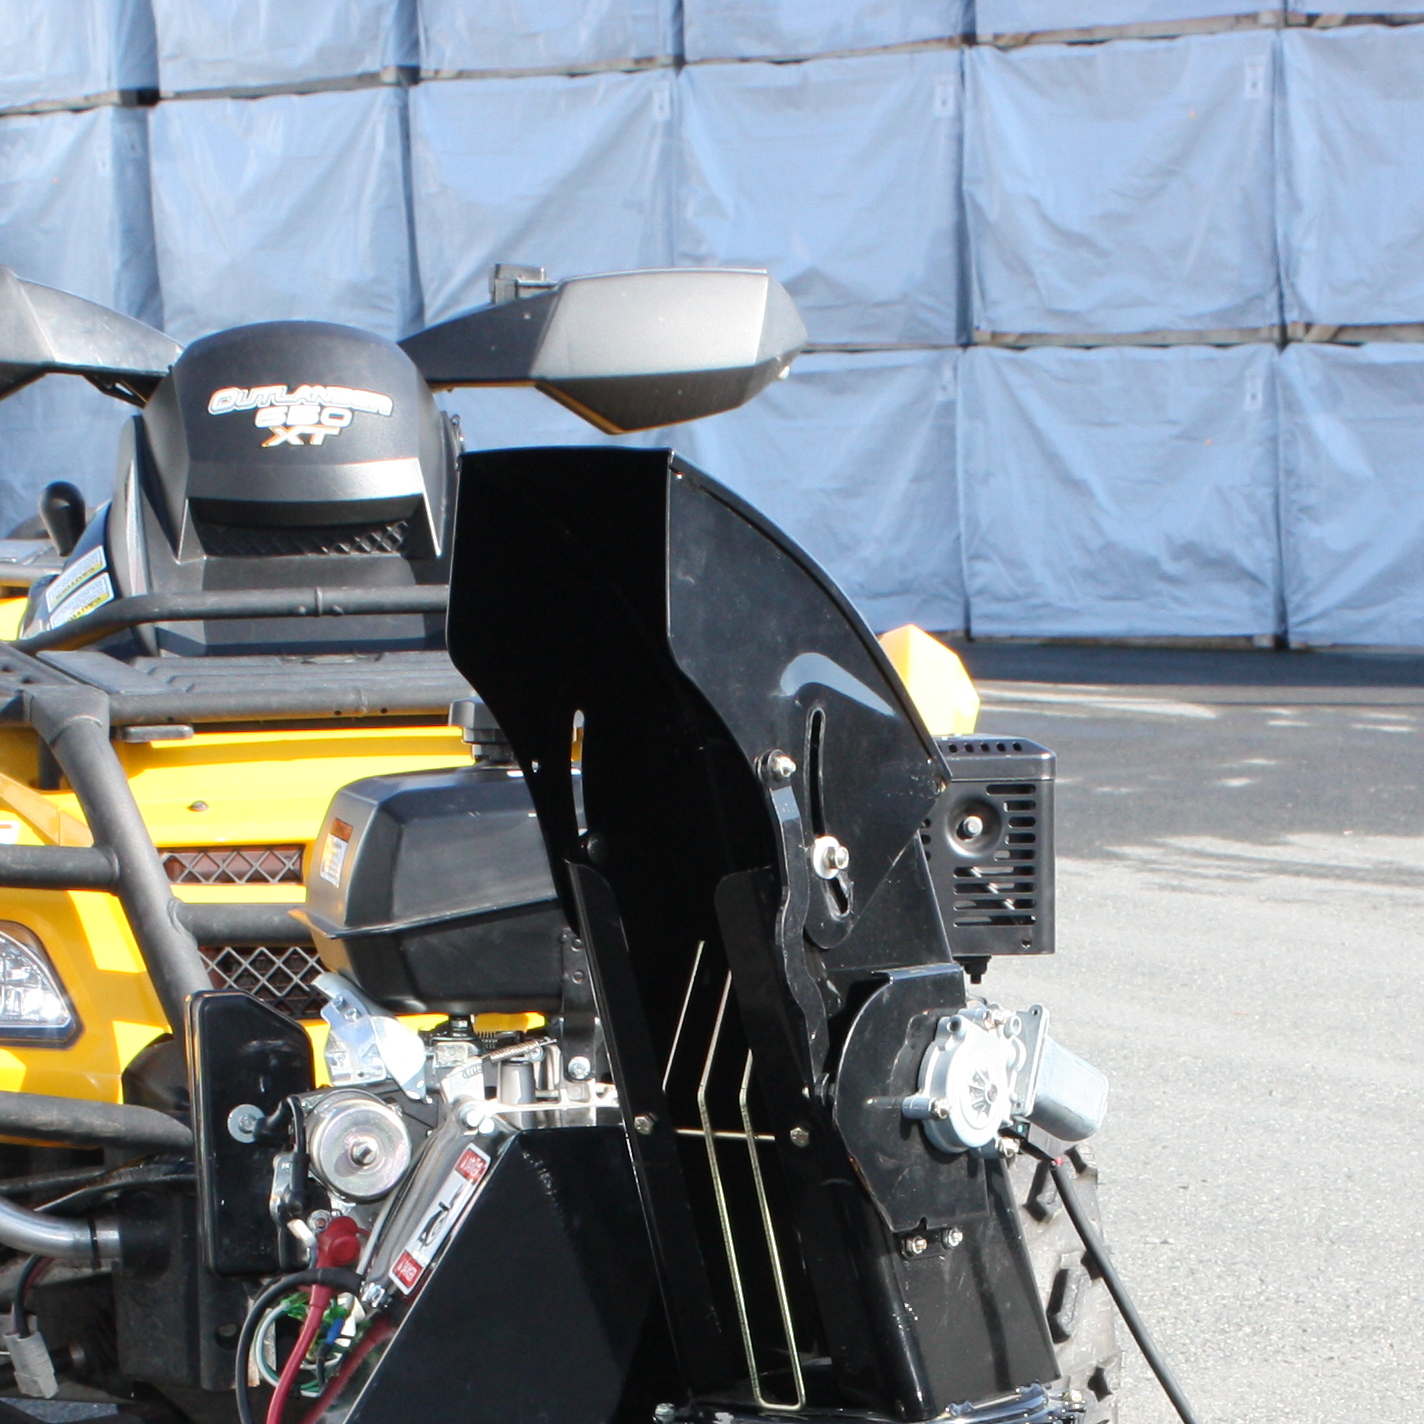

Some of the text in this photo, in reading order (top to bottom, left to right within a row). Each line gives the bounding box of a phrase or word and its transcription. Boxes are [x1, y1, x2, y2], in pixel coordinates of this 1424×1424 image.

[208, 384, 394, 417] OUTLANDER
[255, 406, 354, 428] 650
[261, 425, 342, 448] XT
